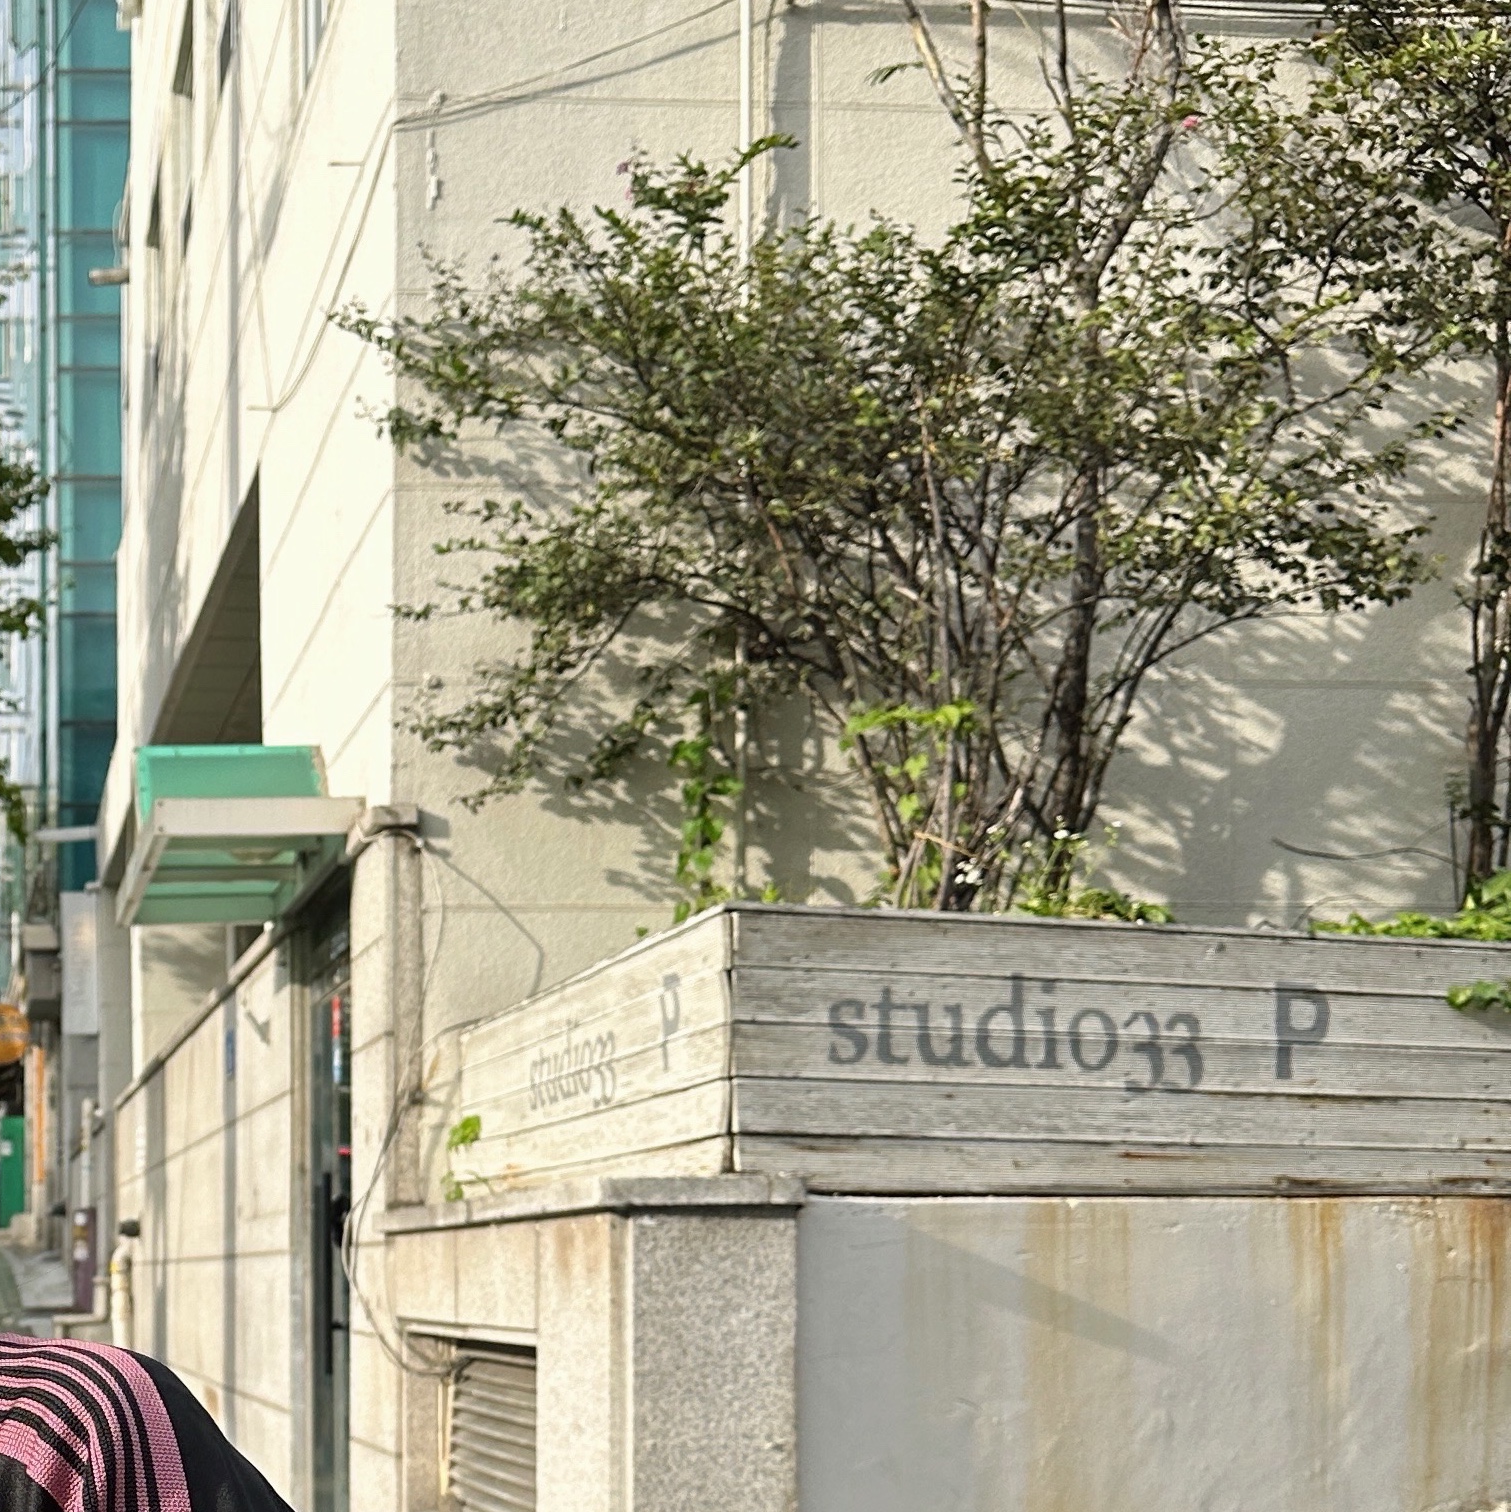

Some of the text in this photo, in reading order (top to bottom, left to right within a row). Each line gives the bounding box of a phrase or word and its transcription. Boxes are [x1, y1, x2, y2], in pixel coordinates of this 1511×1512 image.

[659, 973, 681, 1072] P
[828, 973, 1330, 1093] studio33 P
